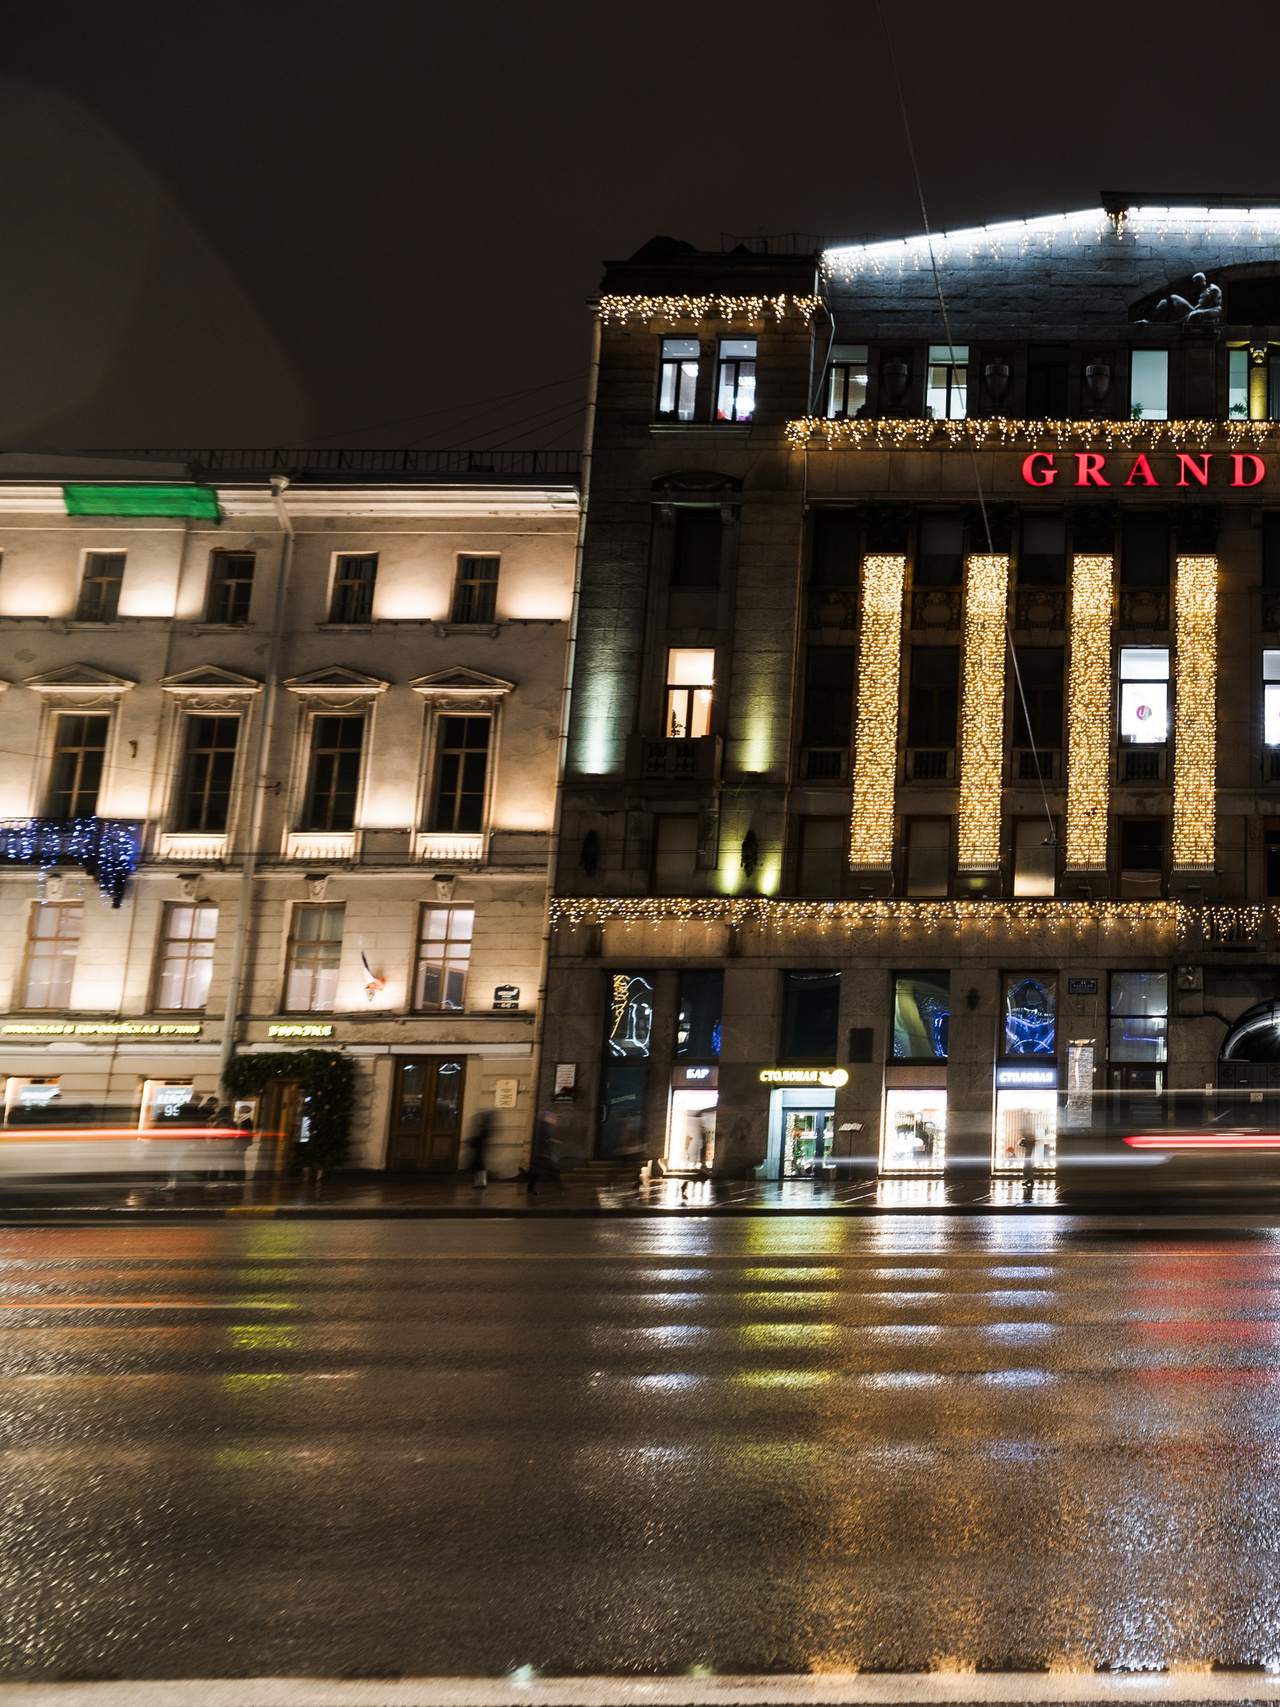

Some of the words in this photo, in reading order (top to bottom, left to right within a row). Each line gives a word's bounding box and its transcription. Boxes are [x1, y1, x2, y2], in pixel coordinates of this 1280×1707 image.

[1021, 451, 1266, 488] GRAND
[686, 1068, 710, 1079] БАР
[759, 1069, 819, 1082] СТОЛОВАЯ
[1000, 1071, 1054, 1083] СТОЛОВАЯ
